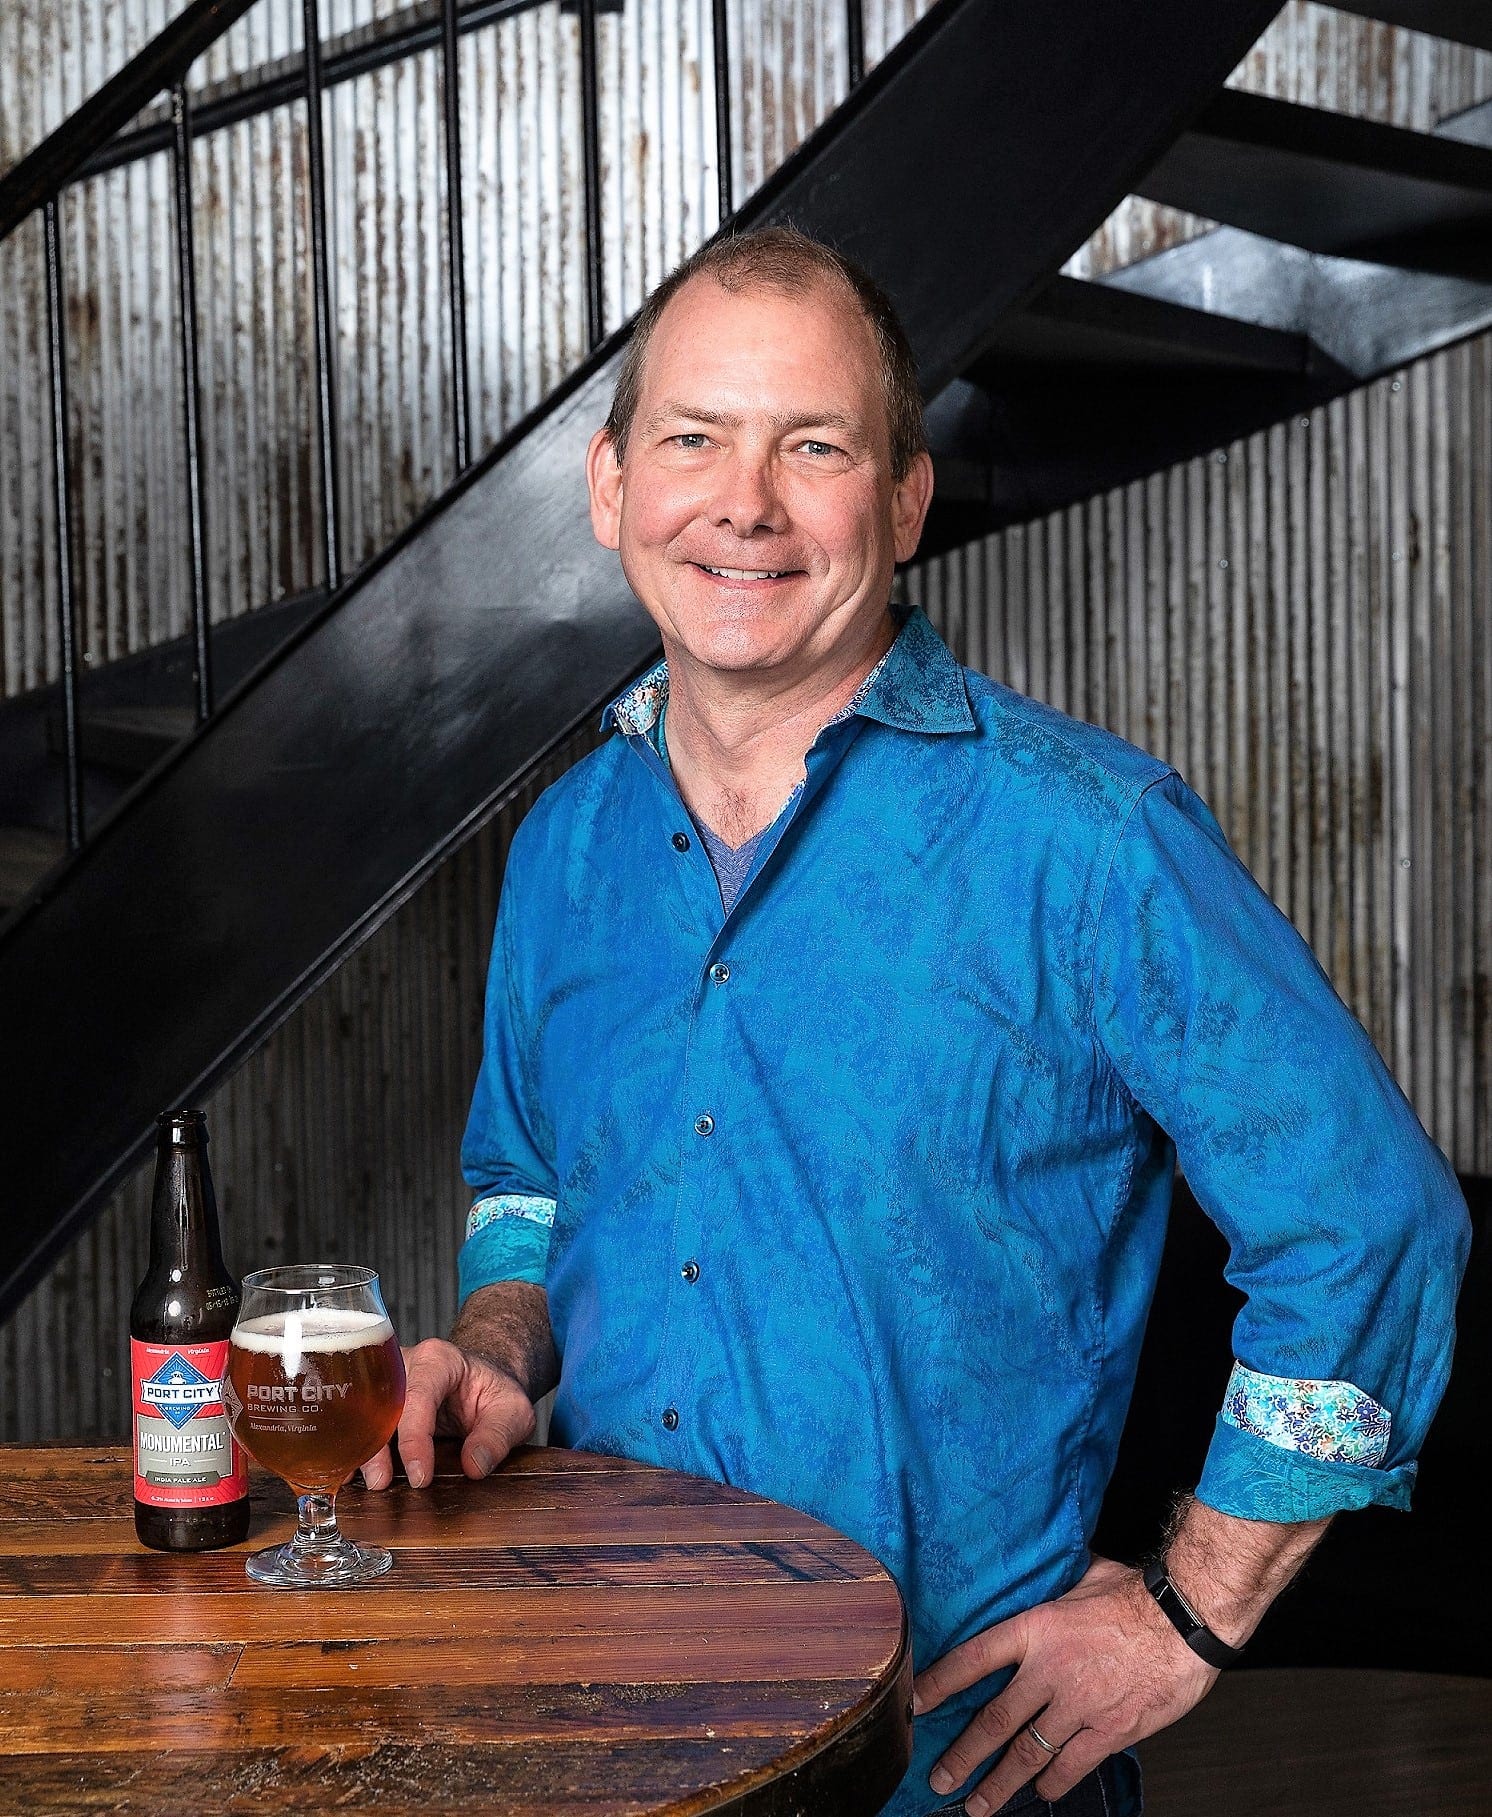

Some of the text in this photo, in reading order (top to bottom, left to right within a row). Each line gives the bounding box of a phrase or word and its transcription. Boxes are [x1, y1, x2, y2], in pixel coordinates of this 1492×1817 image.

[147, 1387, 213, 1399] PORT CITY
[247, 1383, 350, 1402] PORT CITY
[247, 1404, 297, 1413] BREWING
[140, 1432, 224, 1453] MONUMENTAL
[169, 1458, 191, 1467] IPA
